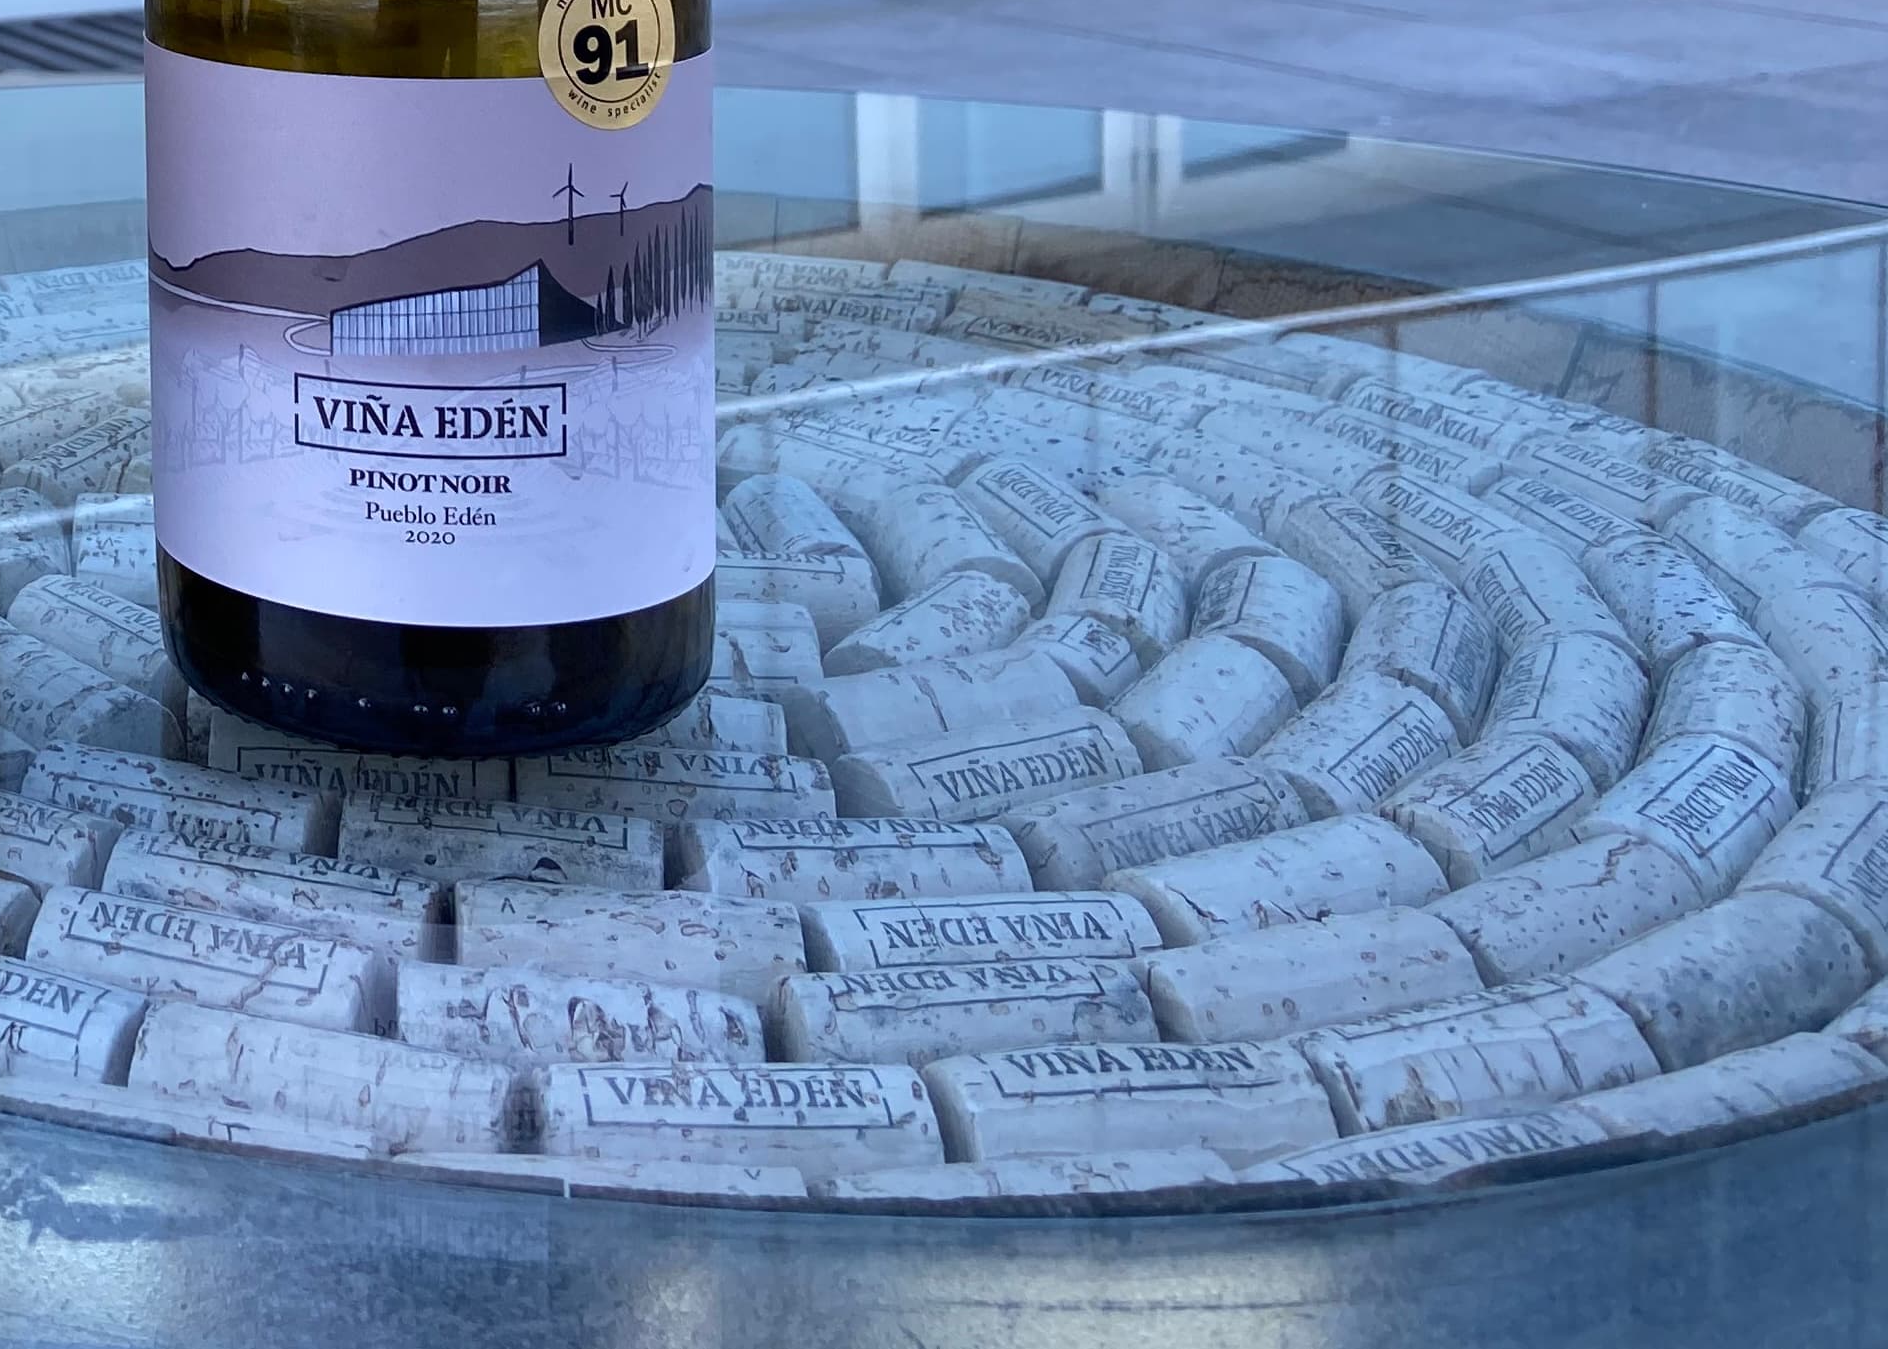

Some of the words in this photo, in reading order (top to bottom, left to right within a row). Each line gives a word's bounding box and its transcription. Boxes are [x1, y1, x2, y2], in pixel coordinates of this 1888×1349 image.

[573, 19, 650, 85] 91
[568, 88, 598, 114] wine
[607, 72, 662, 118] specialist
[313, 394, 424, 438] VIÑA
[434, 398, 550, 439] EDÉN
[349, 468, 437, 493] PINOT
[441, 475, 512, 494] NOIR
[365, 501, 436, 525] Pueblo
[443, 506, 497, 526] Edén
[405, 530, 456, 545] 2020
